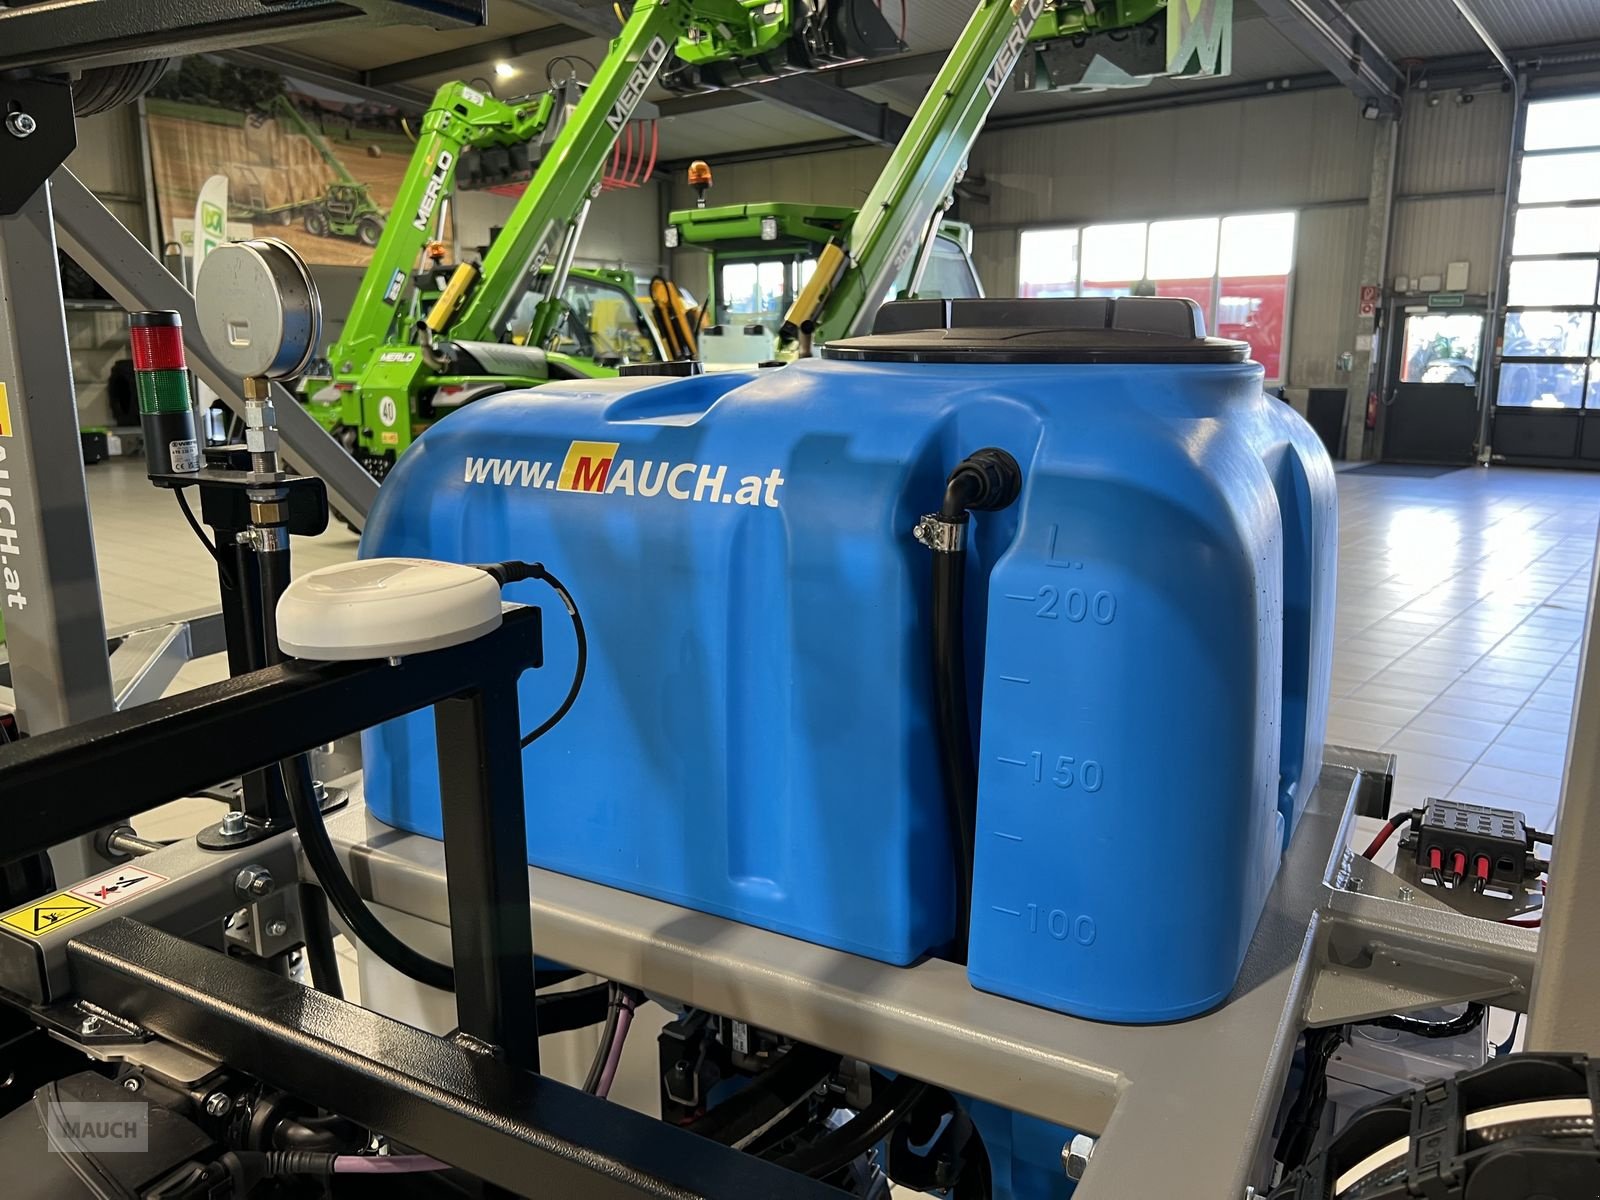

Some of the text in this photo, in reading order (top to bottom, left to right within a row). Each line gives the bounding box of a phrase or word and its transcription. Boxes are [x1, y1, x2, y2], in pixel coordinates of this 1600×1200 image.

[984, 0, 1044, 98] MERLO
[606, 35, 667, 132] MERLO
[413, 149, 454, 232] MERLO
[380, 352, 416, 362] MERLO
[383, 403, 395, 418] 40
[463, 455, 785, 508] www.MAUCH.at
[1036, 584, 1118, 626] 200
[1031, 751, 1104, 793] 150
[1027, 903, 1097, 946] 100
